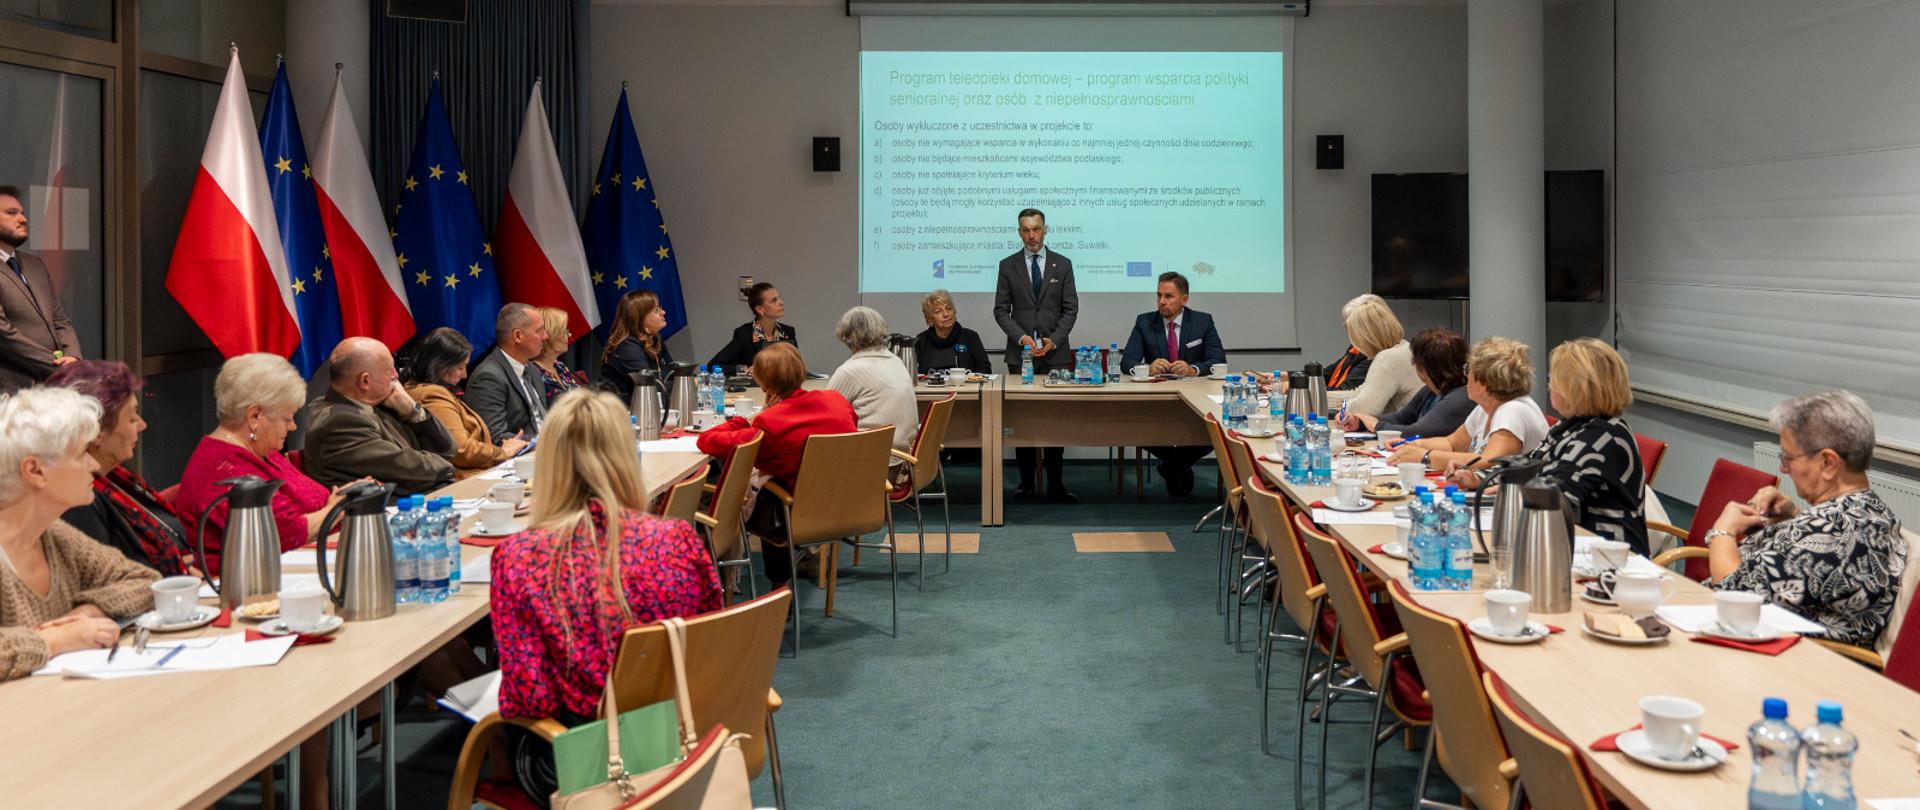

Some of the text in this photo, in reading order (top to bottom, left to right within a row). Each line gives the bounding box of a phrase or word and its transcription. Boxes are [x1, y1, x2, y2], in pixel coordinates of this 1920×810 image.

[890, 70, 946, 87] Program
[950, 70, 1010, 87] teleopieki
[1014, 70, 1072, 87] domowej
[1088, 74, 1141, 87] program
[1145, 70, 1200, 87] wsparcia
[1205, 70, 1248, 87] polityki
[890, 92, 960, 108] senioralnej
[964, 96, 990, 106] oraz
[996, 92, 1026, 106] osób
[1046, 92, 1194, 108] niepełnosprawnościami
[875, 120, 903, 132] Osoby
[906, 120, 958, 132] wykluczone
[970, 120, 1027, 130] uczestnictwa
[1041, 120, 1080, 132] projekcie
[892, 138, 915, 148] osoby
[918, 138, 930, 146] nie
[1028, 138, 1069, 148] wykonaniu
[892, 154, 915, 164] osoby
[918, 154, 930, 162] nie
[892, 170, 915, 180] osoby
[918, 170, 930, 178] nie
[892, 185, 915, 195] osoby
[892, 225, 915, 235] osoby
[892, 241, 915, 250] osoby
